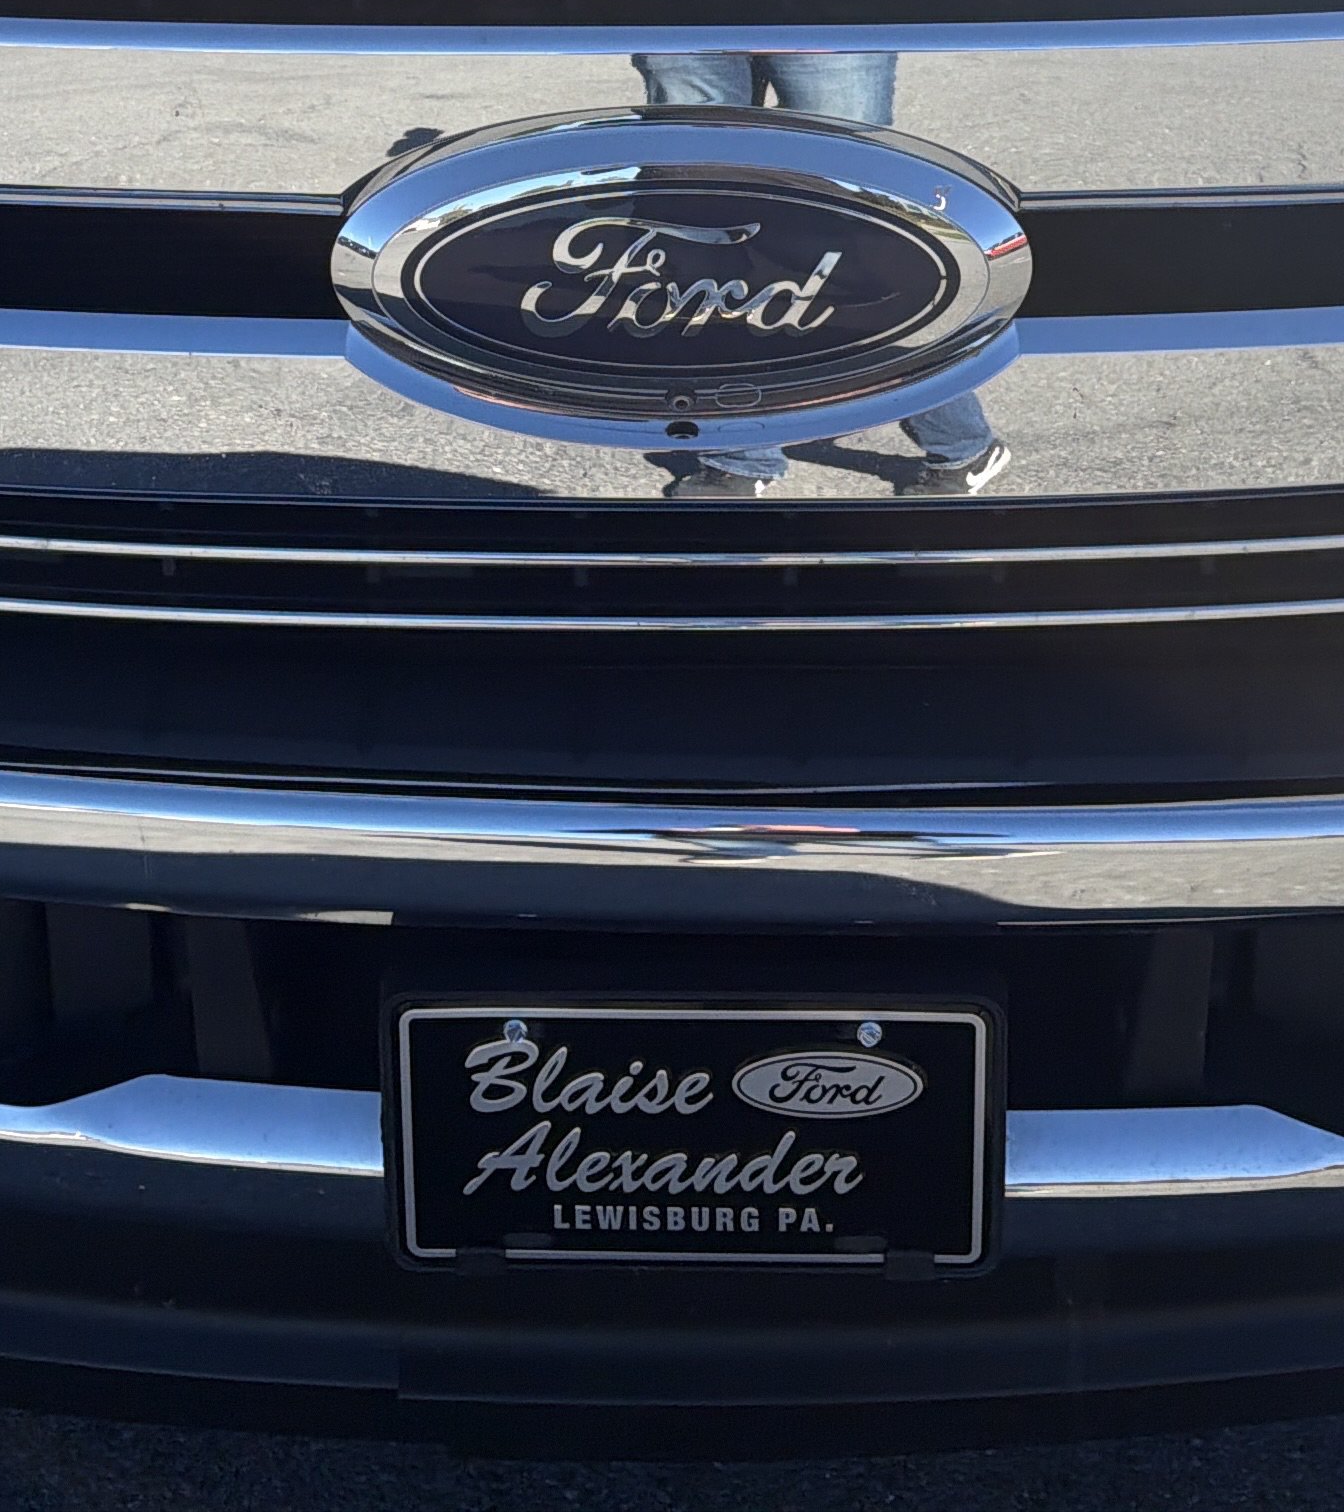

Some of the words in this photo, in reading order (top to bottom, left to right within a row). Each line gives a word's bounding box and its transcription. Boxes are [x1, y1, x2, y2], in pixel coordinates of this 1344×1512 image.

[520, 216, 842, 334] Ford
[464, 1038, 714, 1115] Blaise
[767, 1062, 886, 1106] Ford
[463, 1119, 864, 1196] Alexander
[553, 1203, 760, 1232] LEWISBURG
[778, 1207, 835, 1233] PA.
